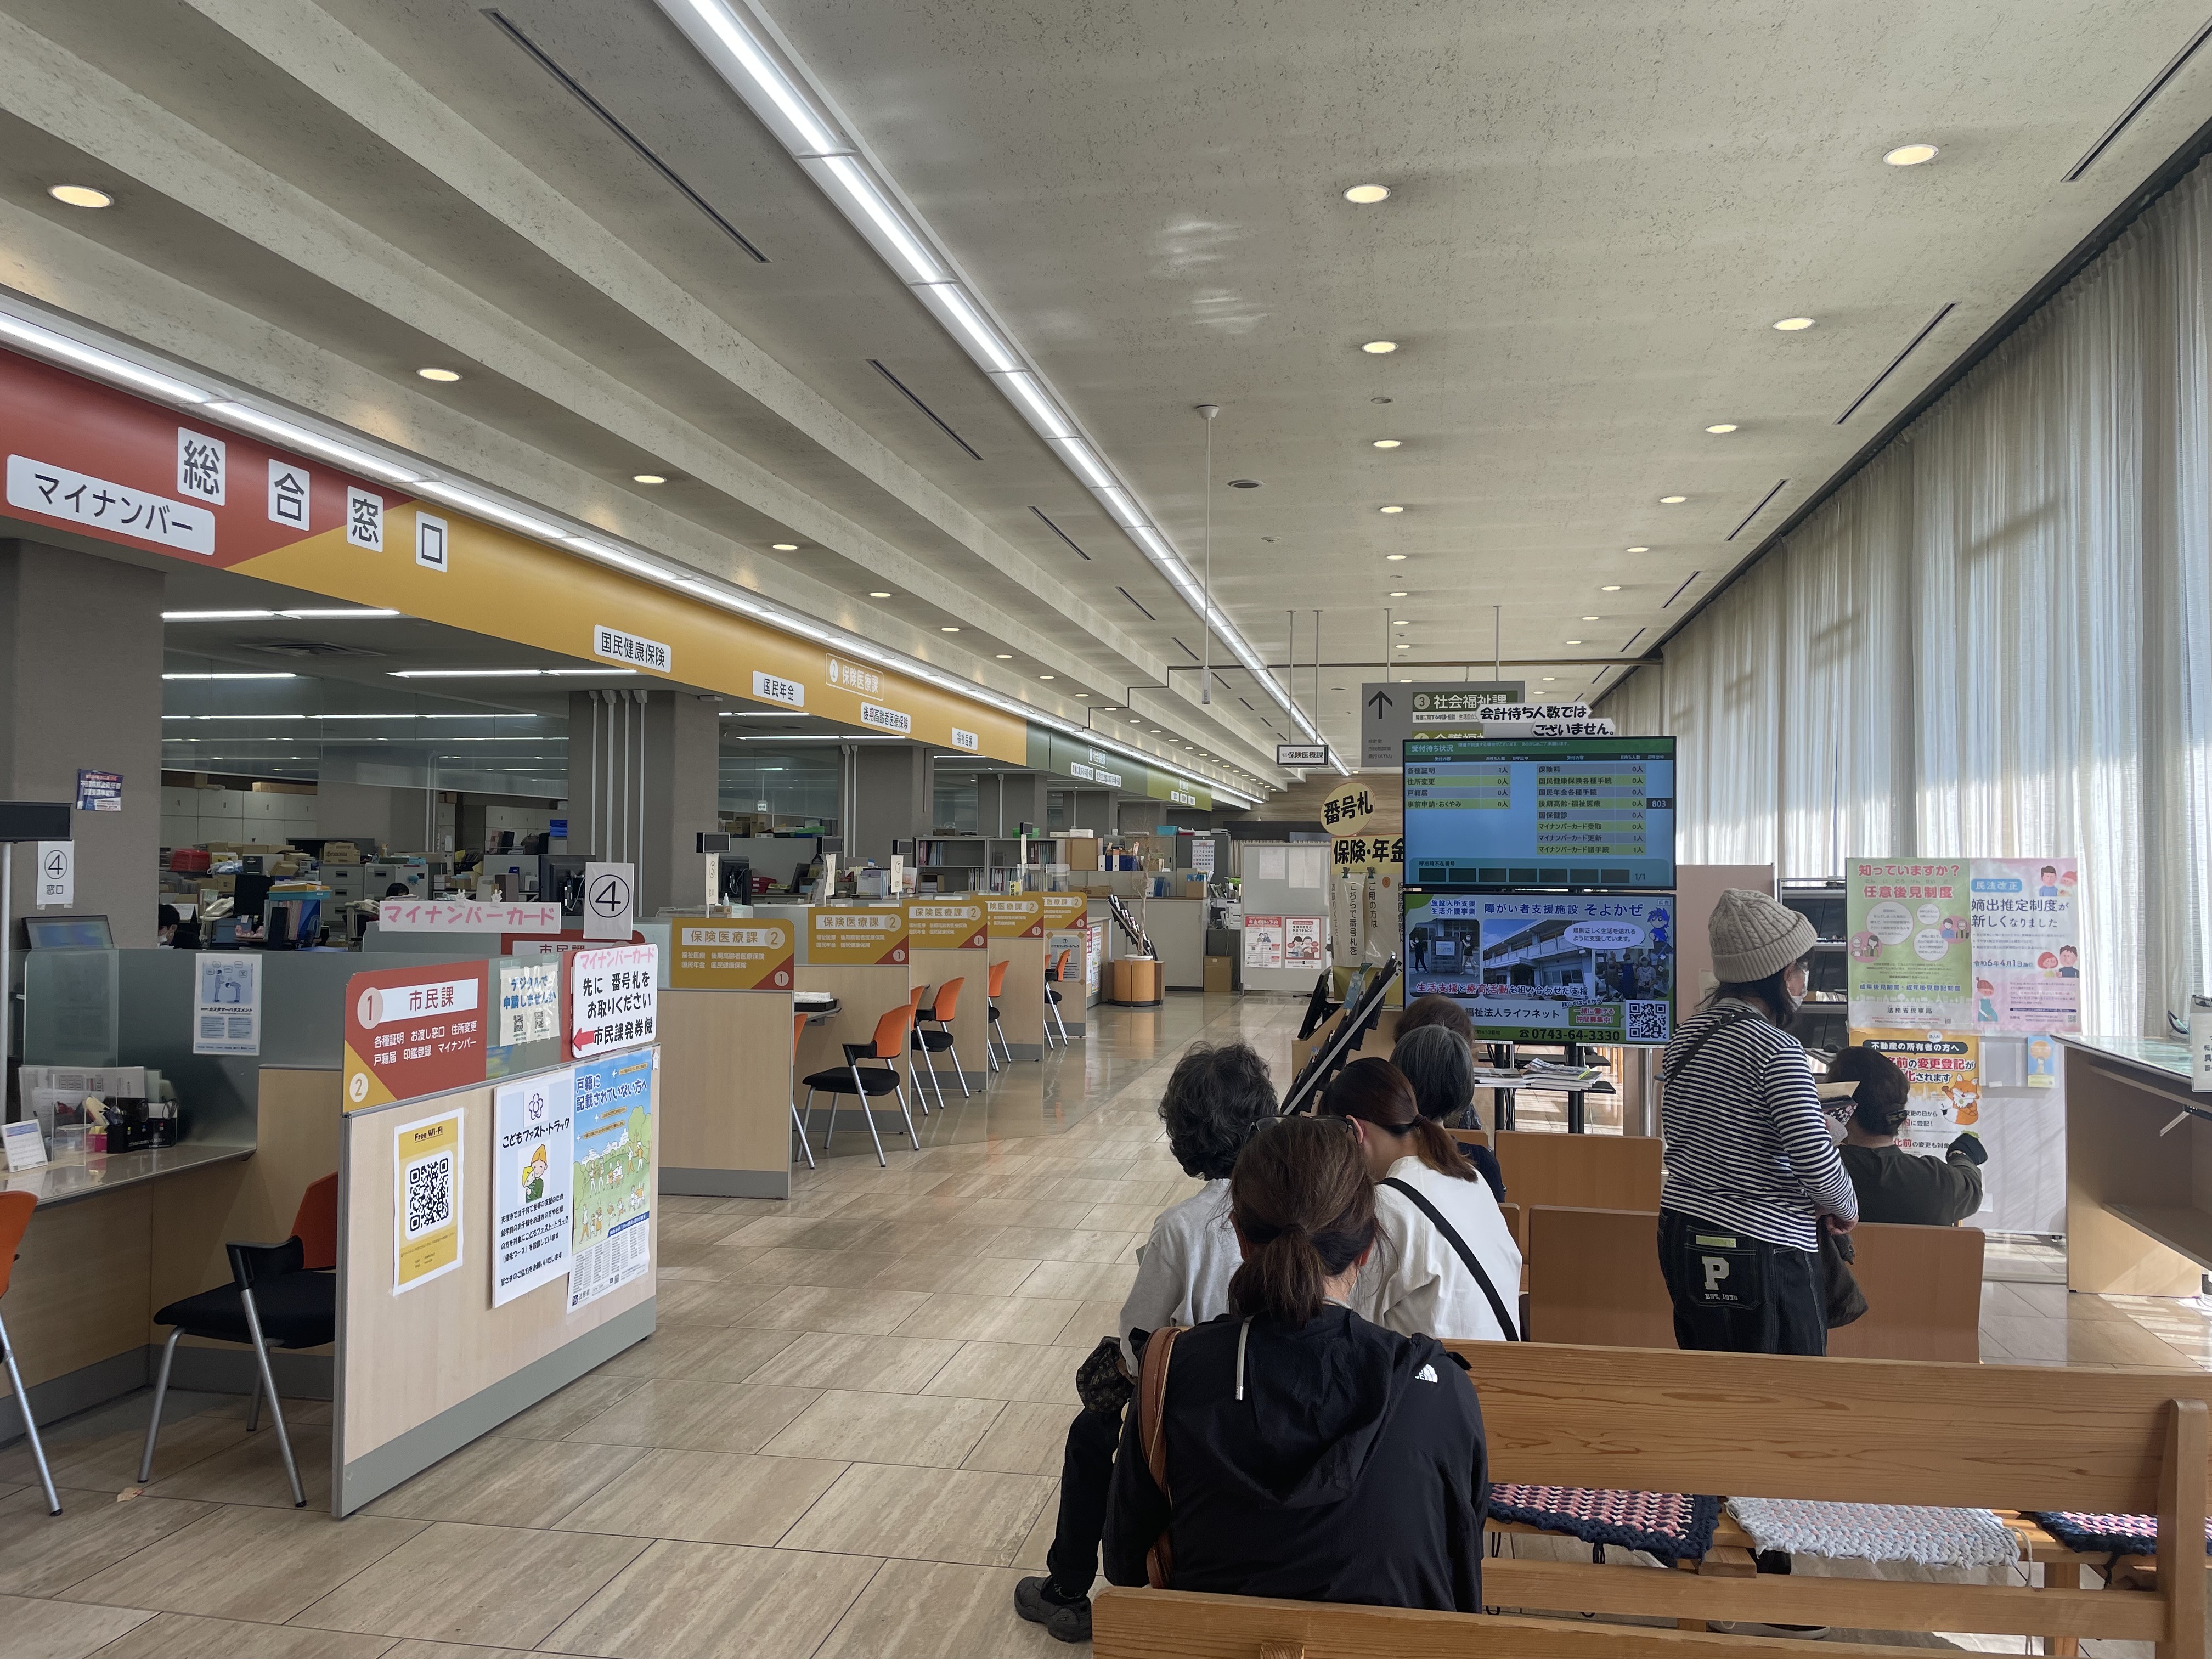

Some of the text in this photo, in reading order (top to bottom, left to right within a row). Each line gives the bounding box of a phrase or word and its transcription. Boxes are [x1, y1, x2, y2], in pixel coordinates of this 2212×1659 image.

[34, 473, 193, 535] マイナンバー
[183, 440, 443, 564] 総合窓口
[601, 632, 665, 668] 国民健康保険
[842, 665, 878, 694] 保険医療課
[764, 678, 794, 701] 国民年金
[1434, 694, 1506, 709] 社会福祉課
[1480, 706, 1587, 720] 会計待ち人数では
[1533, 723, 1613, 736] ございません。
[1412, 744, 1454, 753] 受付待ち状況
[1324, 791, 1373, 826] 番号札
[1333, 838, 1403, 864] 保険・年金
[47, 885, 64, 895] 窓口
[1864, 886, 1953, 898] 任意後見制度
[1976, 881, 2018, 890] 民法改正
[915, 909, 962, 917] 保険医療課
[1485, 903, 1644, 917] 障がい者支援施設 そよかぜ
[1971, 899, 2069, 911] 嫡出推定制度が
[384, 905, 555, 926] マイナンバーカード
[823, 917, 879, 927] 保険医療課
[1972, 915, 2057, 927] 新しくなりました
[691, 930, 758, 943] 保険医療課
[581, 947, 654, 970] マイナンバーカード
[583, 971, 650, 997] 先に 番号札を
[1417, 983, 1588, 995] 生活支援と療育活動を組み合わせた支援
[409, 986, 454, 1011] 市民課
[587, 993, 651, 1019] お取りください
[1562, 999, 1601, 1009] 詳しくはQRから
[374, 1020, 477, 1048] 各種証明 お渡し窓口 住所変更
[594, 1017, 653, 1045] 市民課発券機
[1532, 1029, 1620, 1042] 0743-64-3330
[374, 1037, 477, 1066] 戸籍届 印鑑登録 マイナンバー
[1871, 1042, 1959, 1052] 不動産の所有者の方へ
[576, 1074, 600, 1093] 戸籍に
[576, 1080, 647, 1113] 記載されていない方へ
[415, 1126, 443, 1141] Free Wi-Fi
[503, 1118, 569, 1148] こどもファスト・トラック
[1702, 1256, 1729, 1290] P
